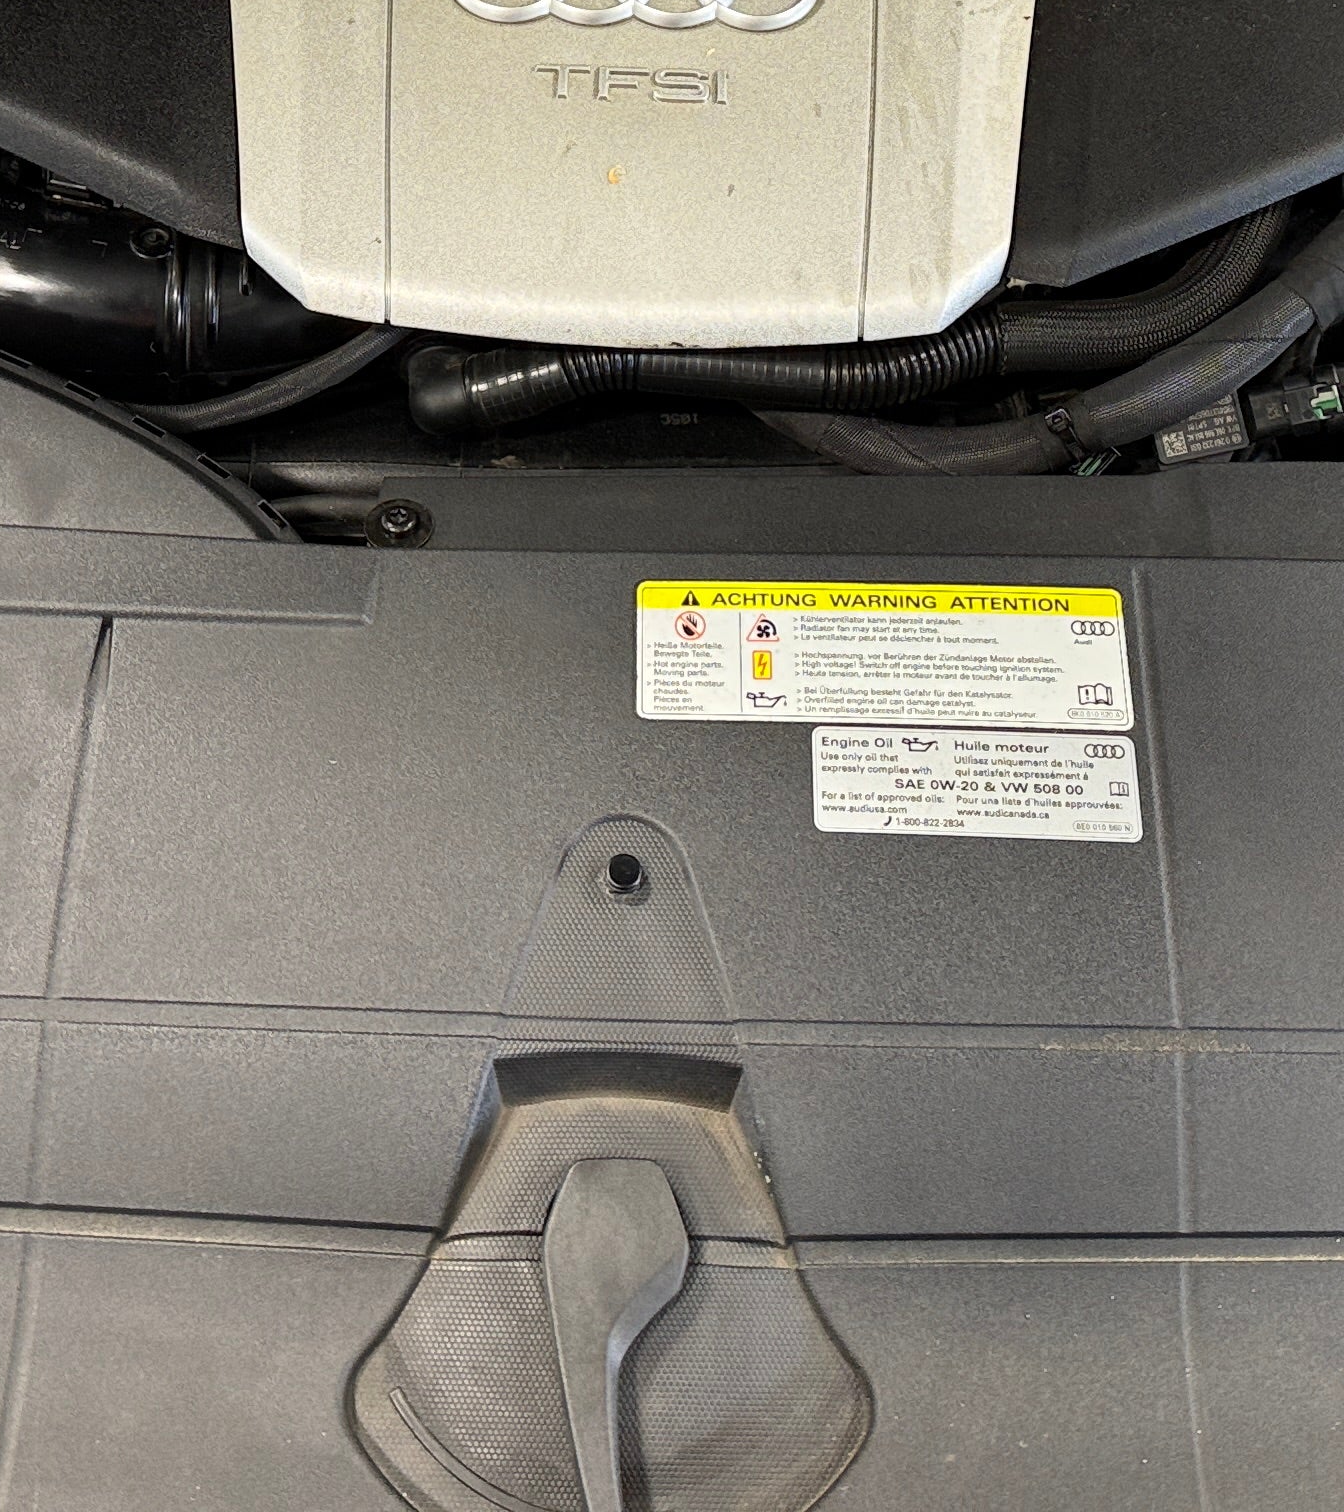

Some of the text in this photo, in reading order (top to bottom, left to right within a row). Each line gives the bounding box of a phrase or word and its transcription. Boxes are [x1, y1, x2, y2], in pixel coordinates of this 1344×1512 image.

[534, 64, 728, 104] TFSI
[712, 593, 1069, 611] ACHTUNG WARNING ATTENTION
[889, 617, 923, 625] jederzeit
[859, 635, 876, 643] peut
[990, 655, 1014, 663] Motor
[802, 661, 821, 669] High
[859, 661, 888, 669] Switch
[933, 663, 959, 671] before
[1000, 665, 1030, 673] ignition
[654, 669, 684, 677] Moving
[904, 689, 930, 697] Gefahr
[934, 689, 945, 697] für
[877, 697, 887, 705] oil
[805, 705, 816, 713] Un
[938, 709, 955, 717] peut
[822, 737, 892, 749] Engine Oil
[954, 741, 1049, 753] Huile moteur
[821, 752, 839, 760] Use
[865, 753, 877, 761] oil
[880, 754, 898, 762] that
[991, 759, 1048, 767] uniquement
[1051, 760, 1062, 768] de
[822, 765, 932, 775] expressly complies with
[955, 769, 970, 777] qui
[895, 779, 1083, 795] SAE 0W-20 & VW 508 00
[822, 791, 837, 799] For
[848, 792, 862, 801] list
[865, 792, 875, 801] of
[878, 795, 922, 803] approved
[956, 795, 978, 804] Pour
[1002, 798, 1021, 806] liste
[822, 805, 907, 814] www.audiusa.com
[957, 809, 1049, 819] www.audicanada.ca
[896, 817, 964, 828] 1-800-822-2834
